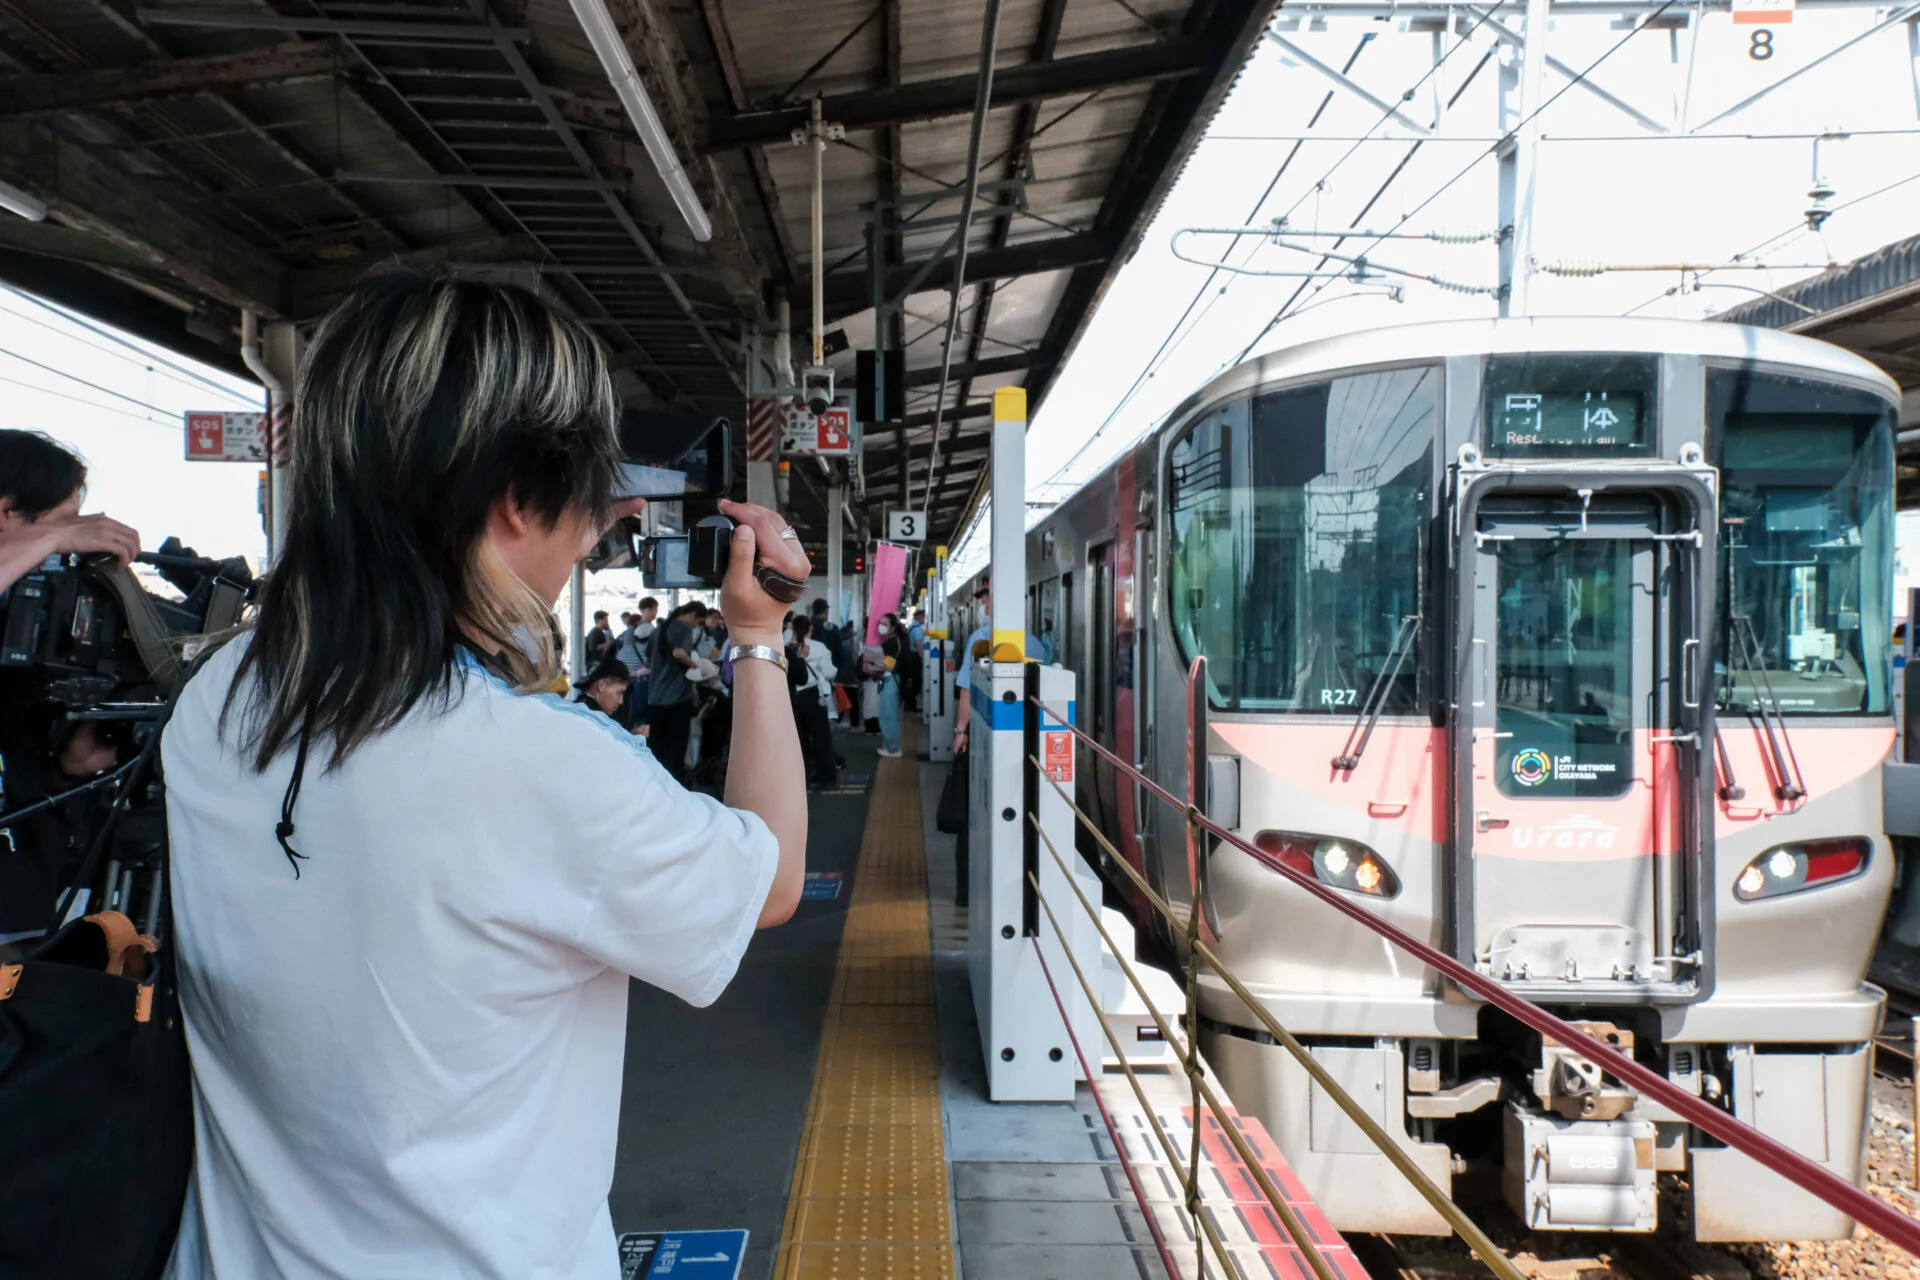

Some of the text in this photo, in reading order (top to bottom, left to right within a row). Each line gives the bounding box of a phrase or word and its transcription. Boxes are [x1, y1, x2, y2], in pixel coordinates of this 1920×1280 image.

[1749, 28, 1774, 61] 8
[192, 420, 220, 430] SOS
[820, 416, 845, 426] SOS
[900, 515, 916, 537] 3
[1321, 689, 1357, 705] R27
[1559, 755, 1572, 764] JR
[1559, 764, 1616, 772] CITY NETWORK
[1559, 772, 1597, 780] OKAYAMA
[1511, 825, 1616, 849] Urara
